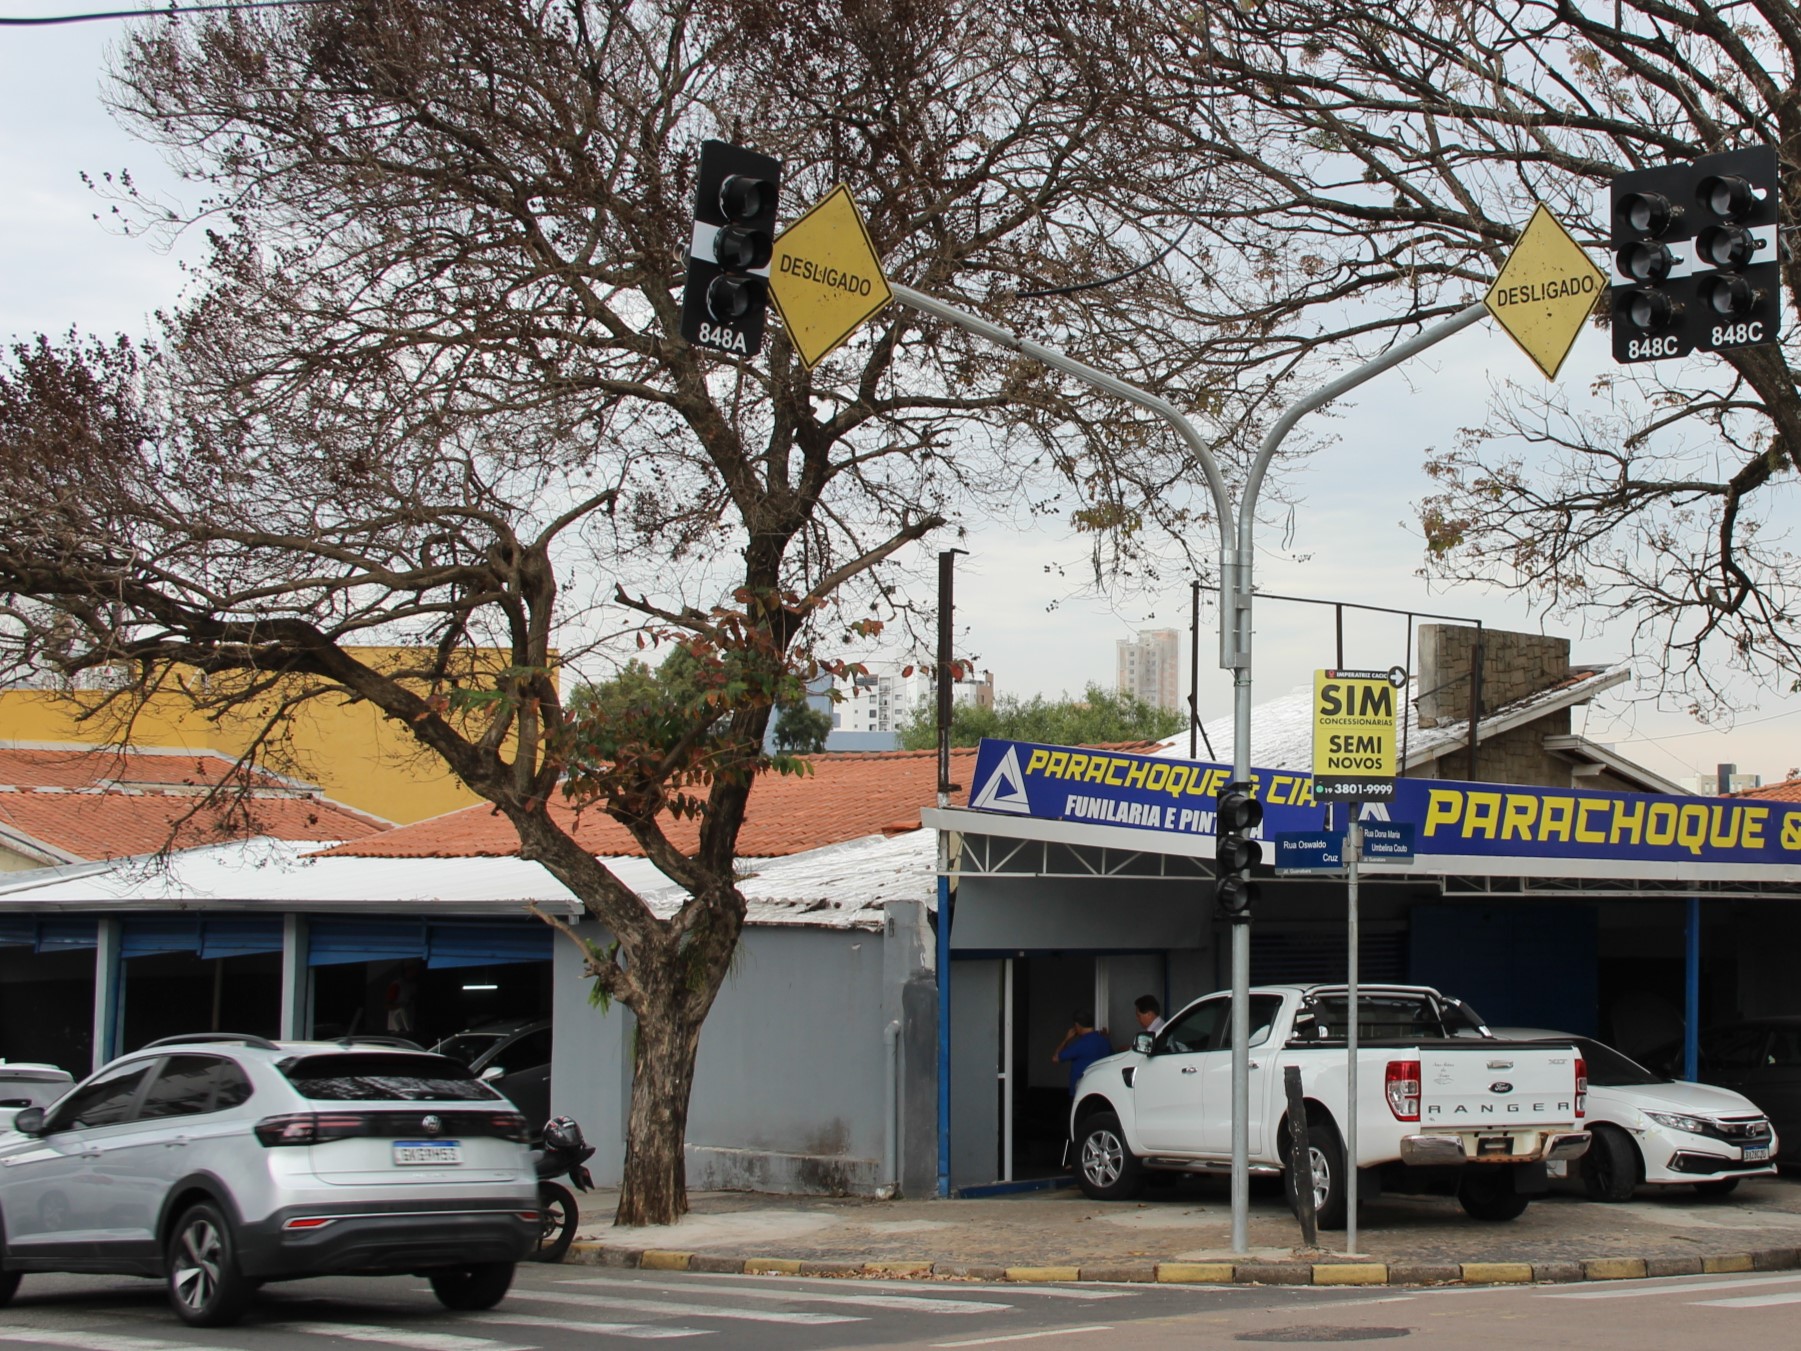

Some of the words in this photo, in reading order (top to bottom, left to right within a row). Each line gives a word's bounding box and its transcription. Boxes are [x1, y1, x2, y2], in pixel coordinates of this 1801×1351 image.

[779, 253, 872, 297] DESLIGADO
[1497, 274, 1594, 307] DESLIGADO
[698, 322, 747, 353] 848A
[1711, 321, 1763, 346] 848C
[1628, 335, 1678, 359] 848C
[1320, 684, 1393, 717] SIM
[1329, 735, 1382, 754] SEMI
[1025, 748, 1232, 799] PARACHOQUE
[1328, 757, 1382, 770] NOVOS
[1334, 783, 1393, 795] 3801-9999
[1065, 795, 1162, 828] FUNILARIA
[1164, 808, 1175, 829] E
[1423, 789, 1769, 855] PARACHOQUE
[1283, 841, 1297, 849] Rua
[1298, 840, 1327, 849] Oswaldo
[1364, 829, 1374, 838] Rua
[1374, 830, 1387, 838] Dona
[1387, 831, 1401, 839] Maria
[1322, 853, 1338, 862] Cruz
[1371, 843, 1393, 852] Umbelina
[1393, 844, 1408, 853] Couto
[1494, 1082, 1510, 1091] Ford
[1428, 1101, 1569, 1114] RANGER
